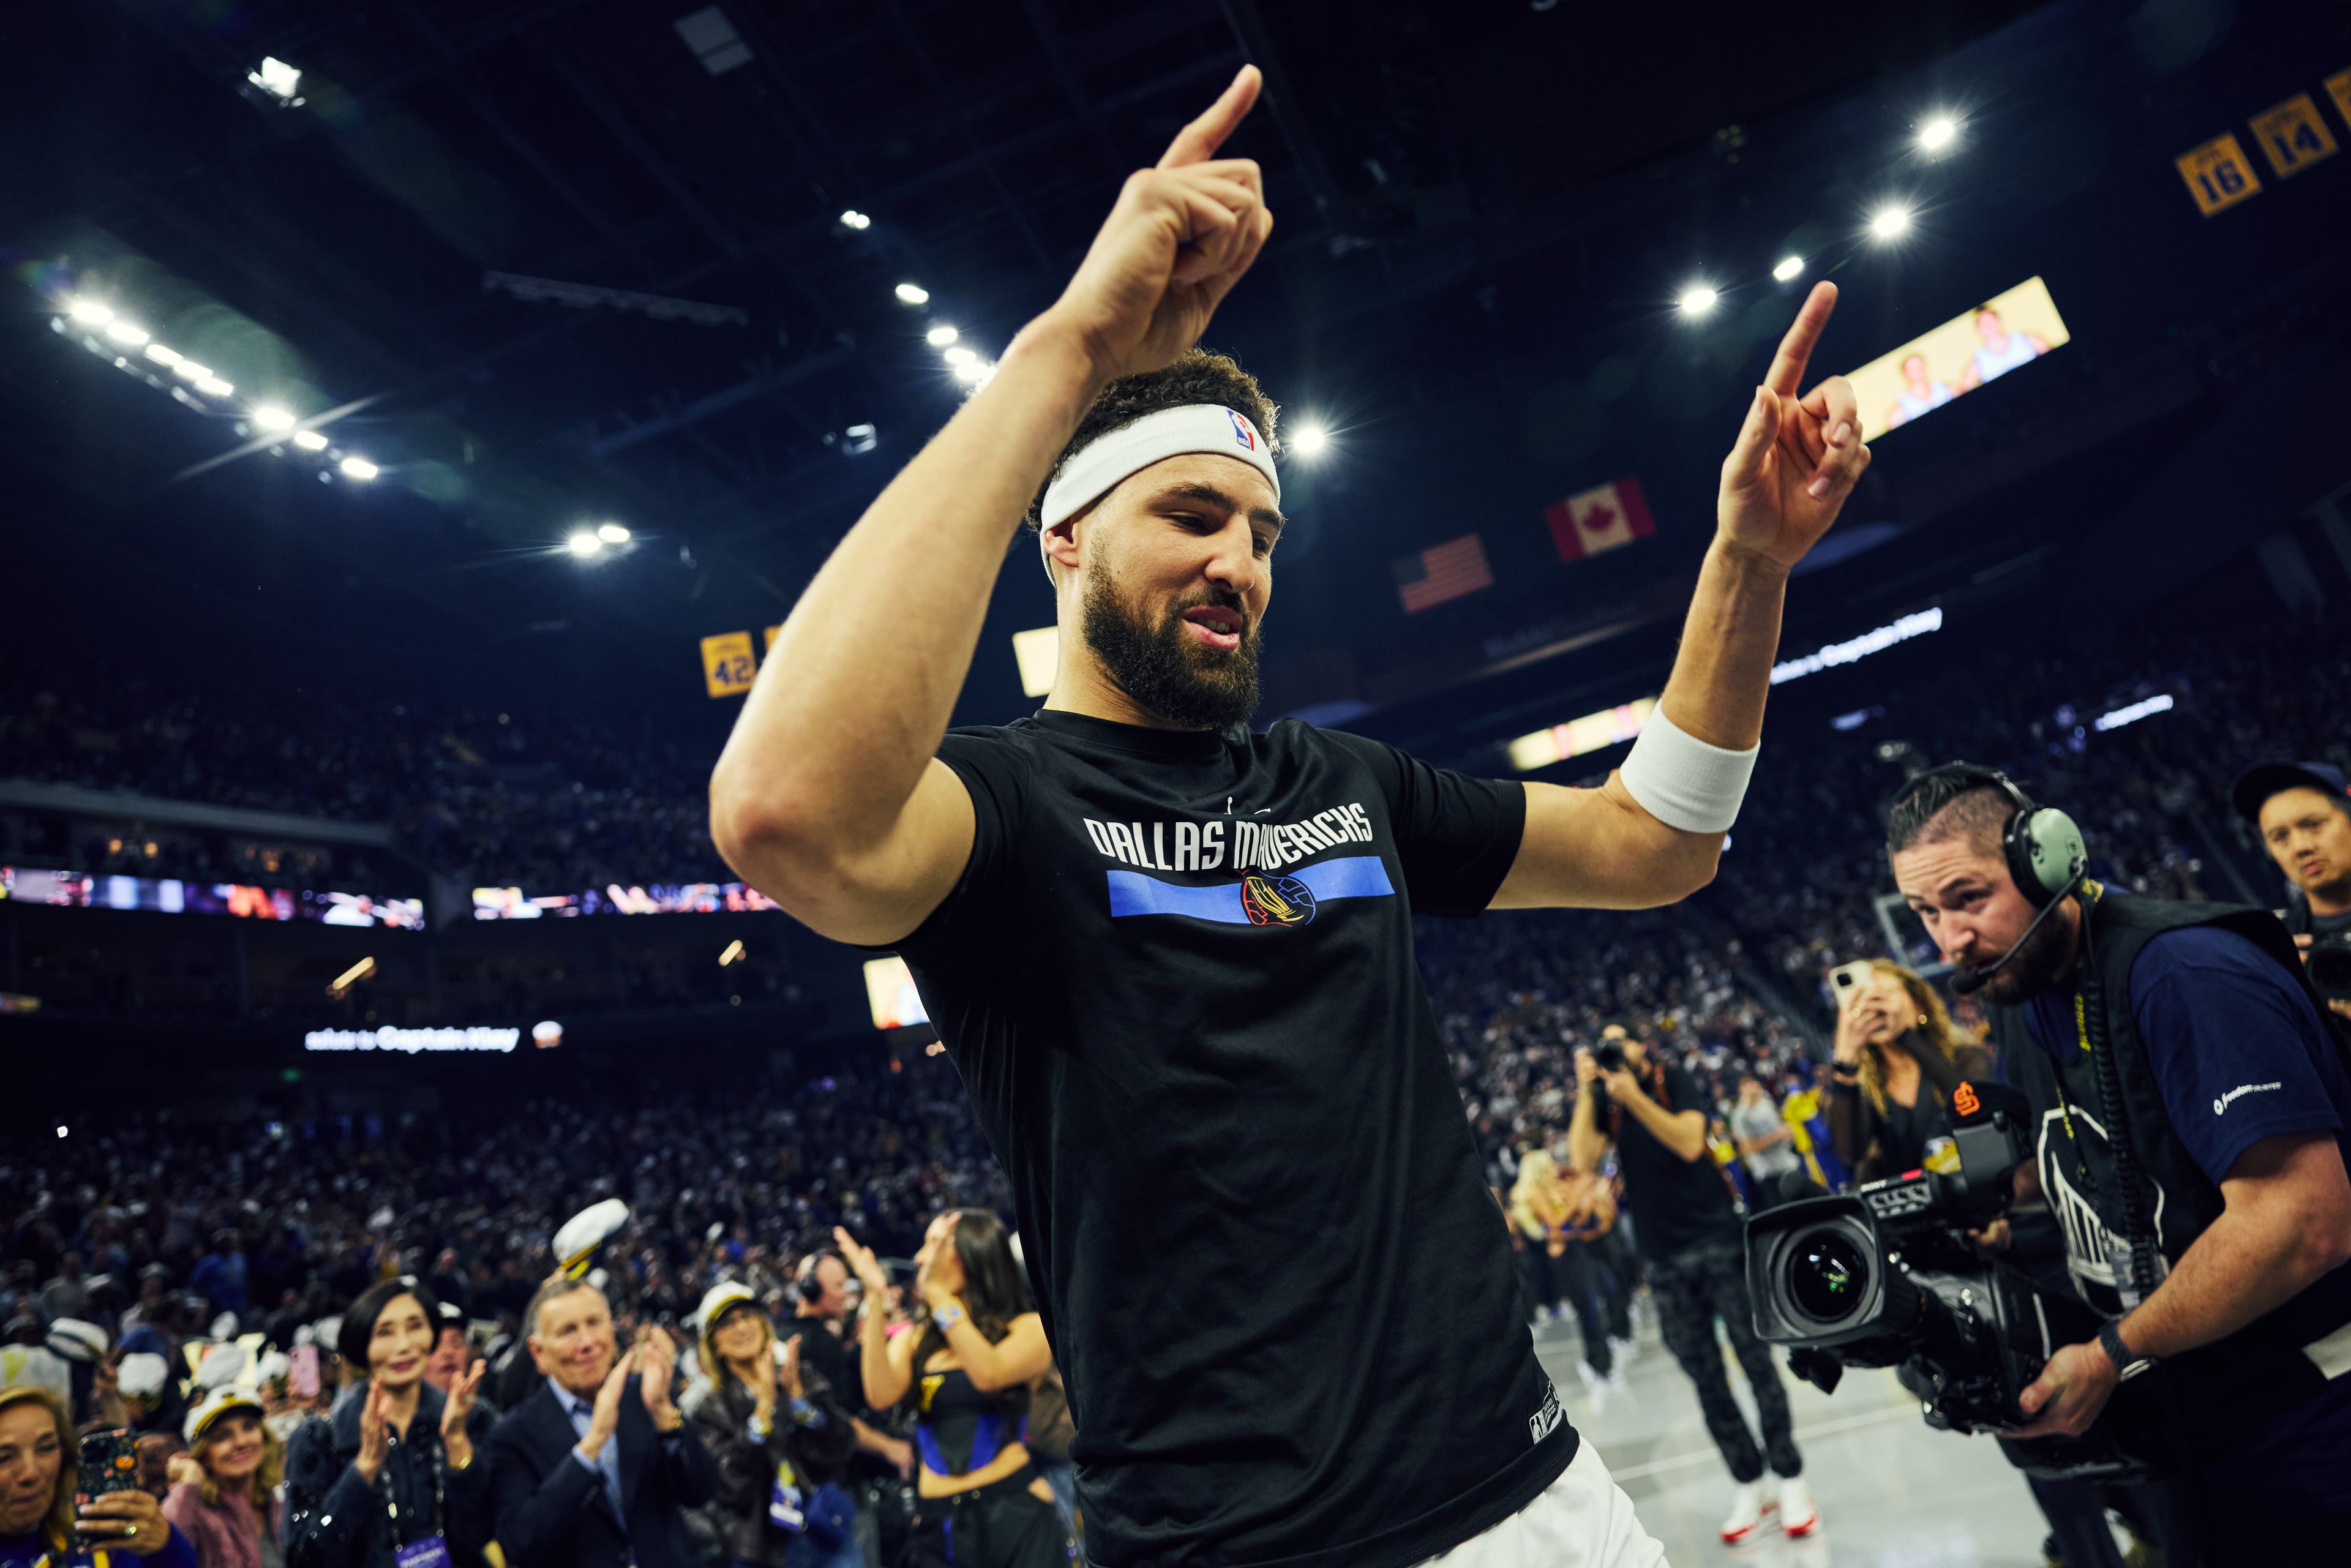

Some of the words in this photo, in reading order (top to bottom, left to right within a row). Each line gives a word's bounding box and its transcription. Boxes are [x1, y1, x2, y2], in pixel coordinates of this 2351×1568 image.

[2273, 121, 2323, 166] 14
[2197, 159, 2246, 203] 16
[1237, 437, 1250, 448] NBA
[714, 655, 751, 685] 42
[1083, 817, 1225, 872] DALLAS
[1234, 803, 1373, 871] MAVERICKS
